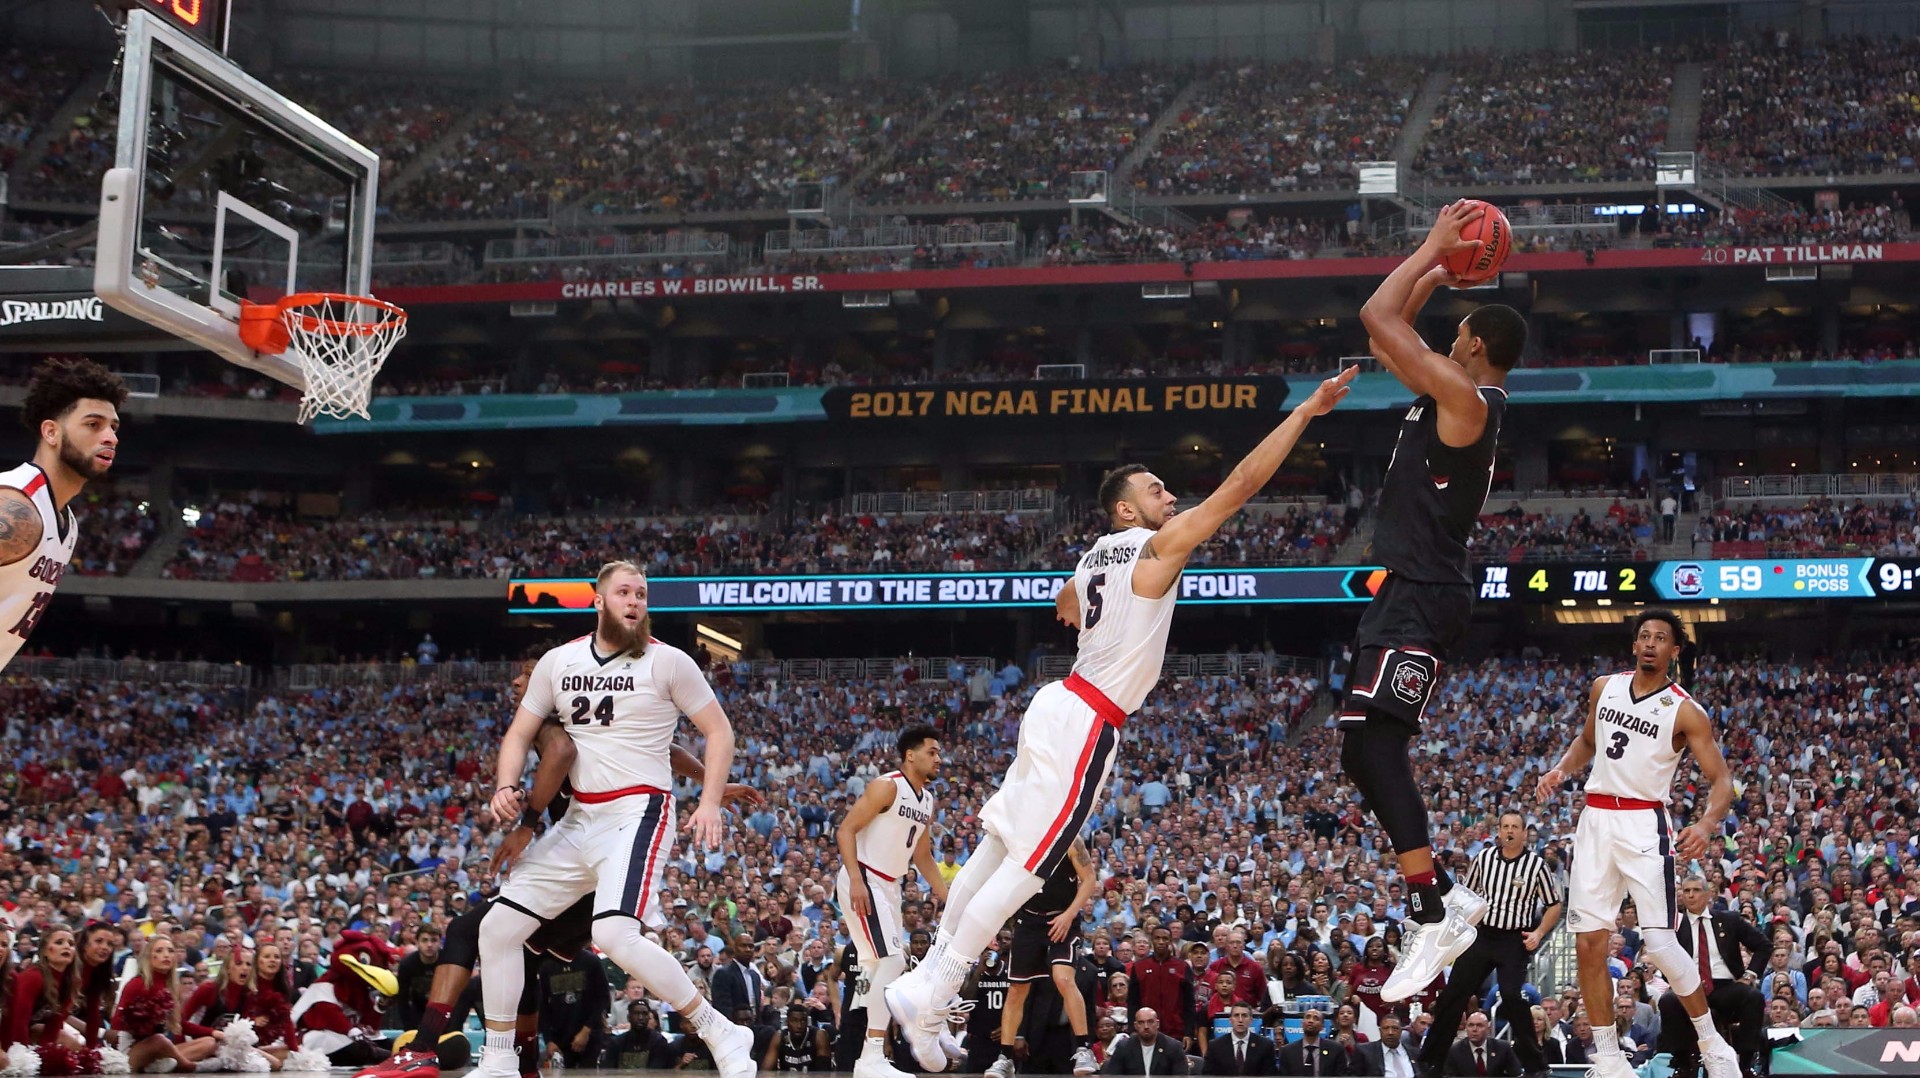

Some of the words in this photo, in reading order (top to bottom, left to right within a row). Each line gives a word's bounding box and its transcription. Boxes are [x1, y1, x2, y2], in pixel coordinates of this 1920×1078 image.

[1475, 221, 1500, 270] Wilson
[1700, 248, 1727, 263] 40
[1734, 247, 1776, 262] PAT
[1783, 245, 1883, 261] TILLMAN
[561, 281, 655, 298] CHARLES
[662, 280, 688, 294] W.
[694, 277, 785, 294] BIDWILL,
[792, 276, 824, 290] SR.
[0, 296, 104, 326] SPALDING
[850, 391, 935, 417] 2017
[946, 390, 1038, 416] NCAA
[1050, 387, 1153, 414] FINAL
[1164, 384, 1257, 411] FOUR
[1485, 567, 1508, 582] TM
[1528, 569, 1549, 591] 4
[1573, 570, 1609, 591] TOL
[1618, 568, 1636, 590] 2
[1719, 565, 1762, 592] 59
[1796, 564, 1849, 577] BONUS
[1879, 562, 1920, 591] 9:
[698, 581, 832, 604] WELCOME
[838, 580, 873, 602] TO
[879, 579, 931, 602] THE
[938, 578, 1004, 601] 2017
[1012, 577, 1066, 600] NCA
[1182, 574, 1257, 598] FOUR
[1480, 583, 1511, 598] FLS.
[1808, 579, 1849, 592] POSS
[1085, 573, 1106, 629] 5
[561, 676, 635, 692] GONZAGA
[571, 695, 615, 726] 24
[1598, 706, 1660, 739] GONZAGA
[1606, 731, 1630, 760] 3
[898, 805, 931, 825] GONZAG
[906, 825, 917, 848] 0
[986, 990, 1003, 1010] 10
